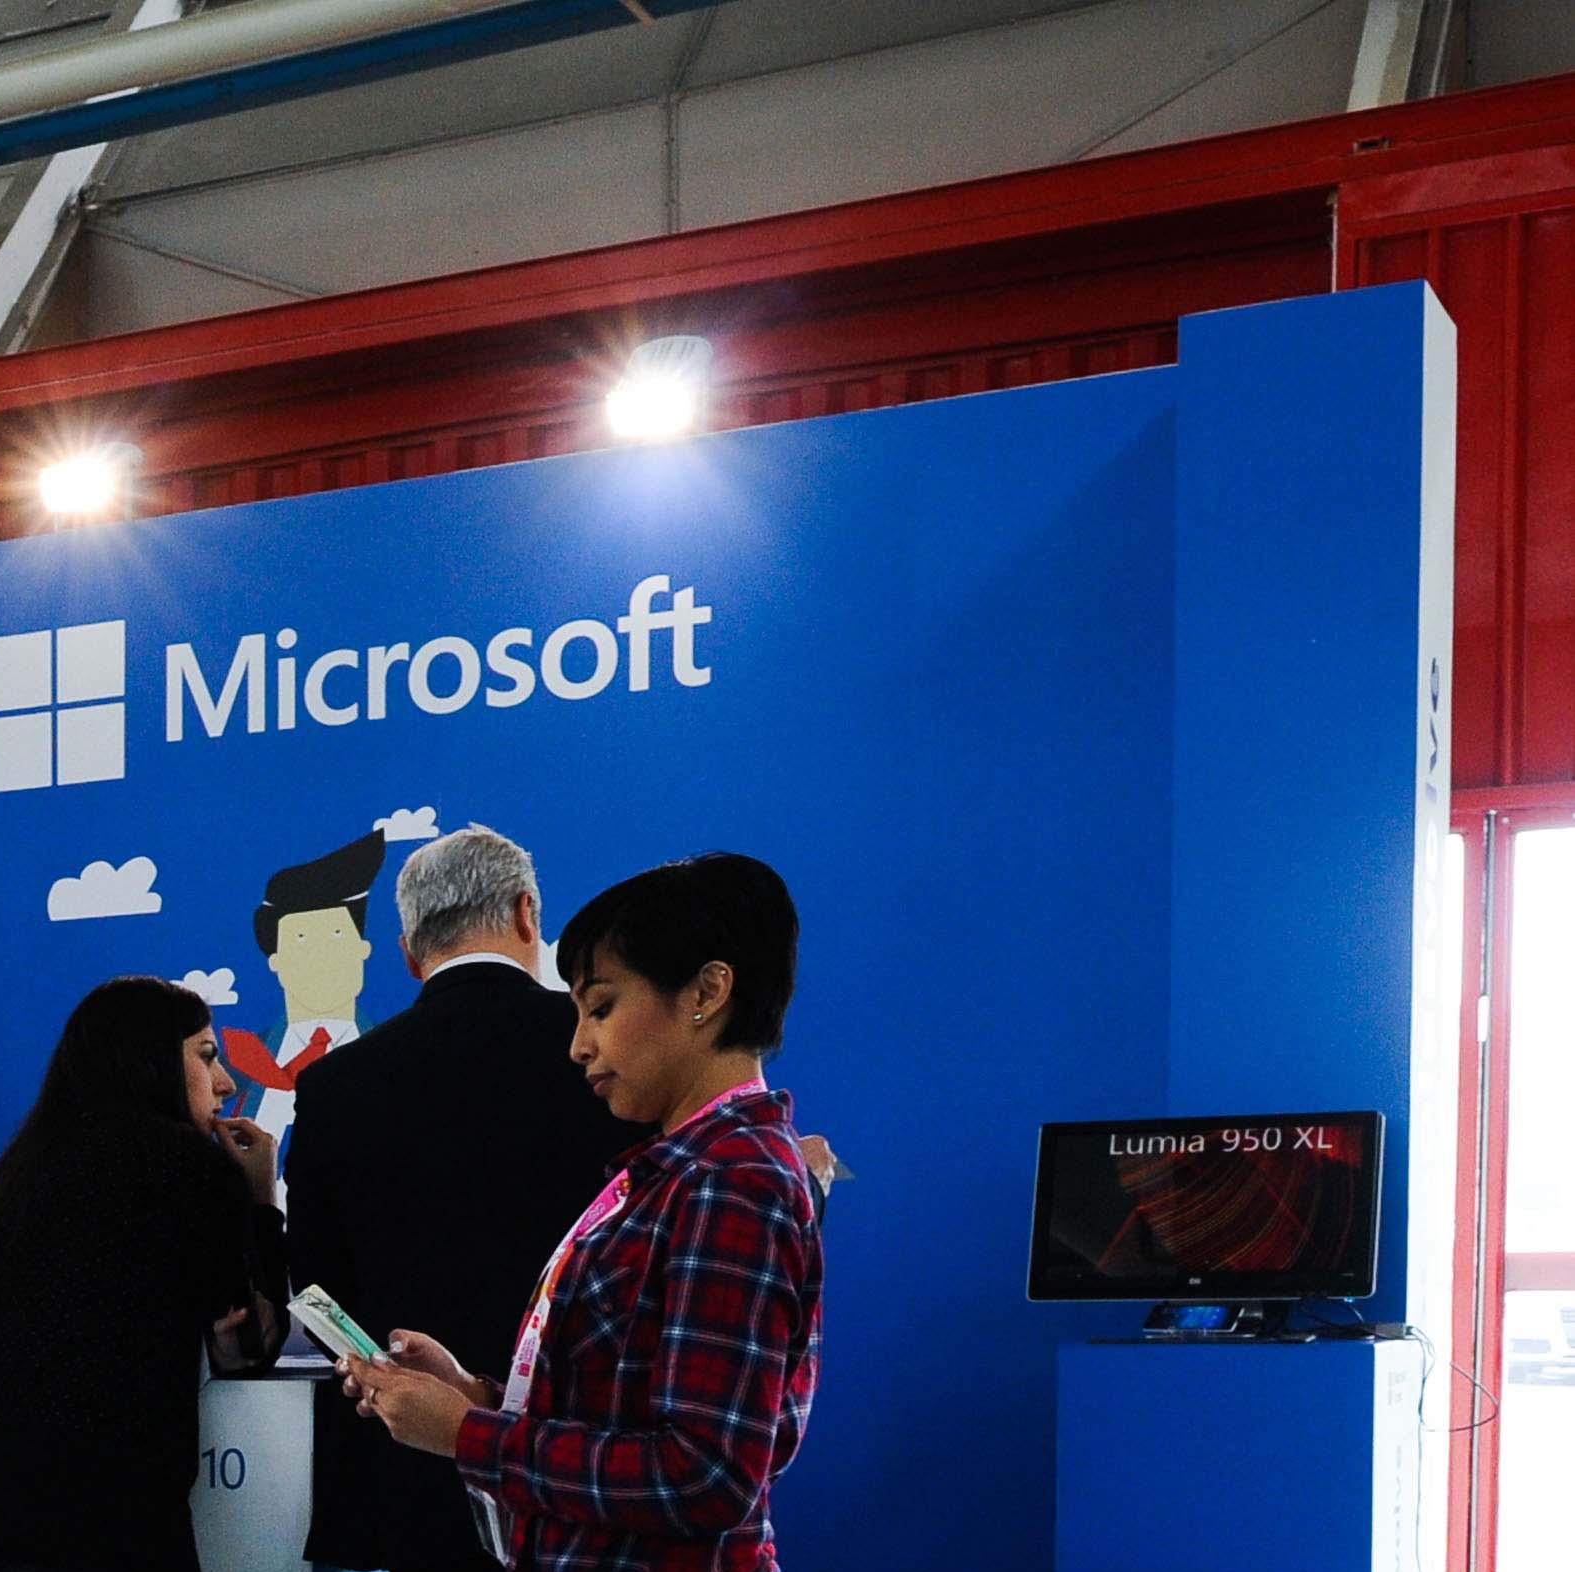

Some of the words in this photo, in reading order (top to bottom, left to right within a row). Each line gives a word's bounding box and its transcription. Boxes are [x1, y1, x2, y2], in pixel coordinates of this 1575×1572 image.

[166, 575, 712, 742] Microsoft
[1109, 1133, 1206, 1155] Lumia
[1221, 1127, 1282, 1152] 950
[1293, 1125, 1333, 1150] XL
[201, 1447, 246, 1490] 10
